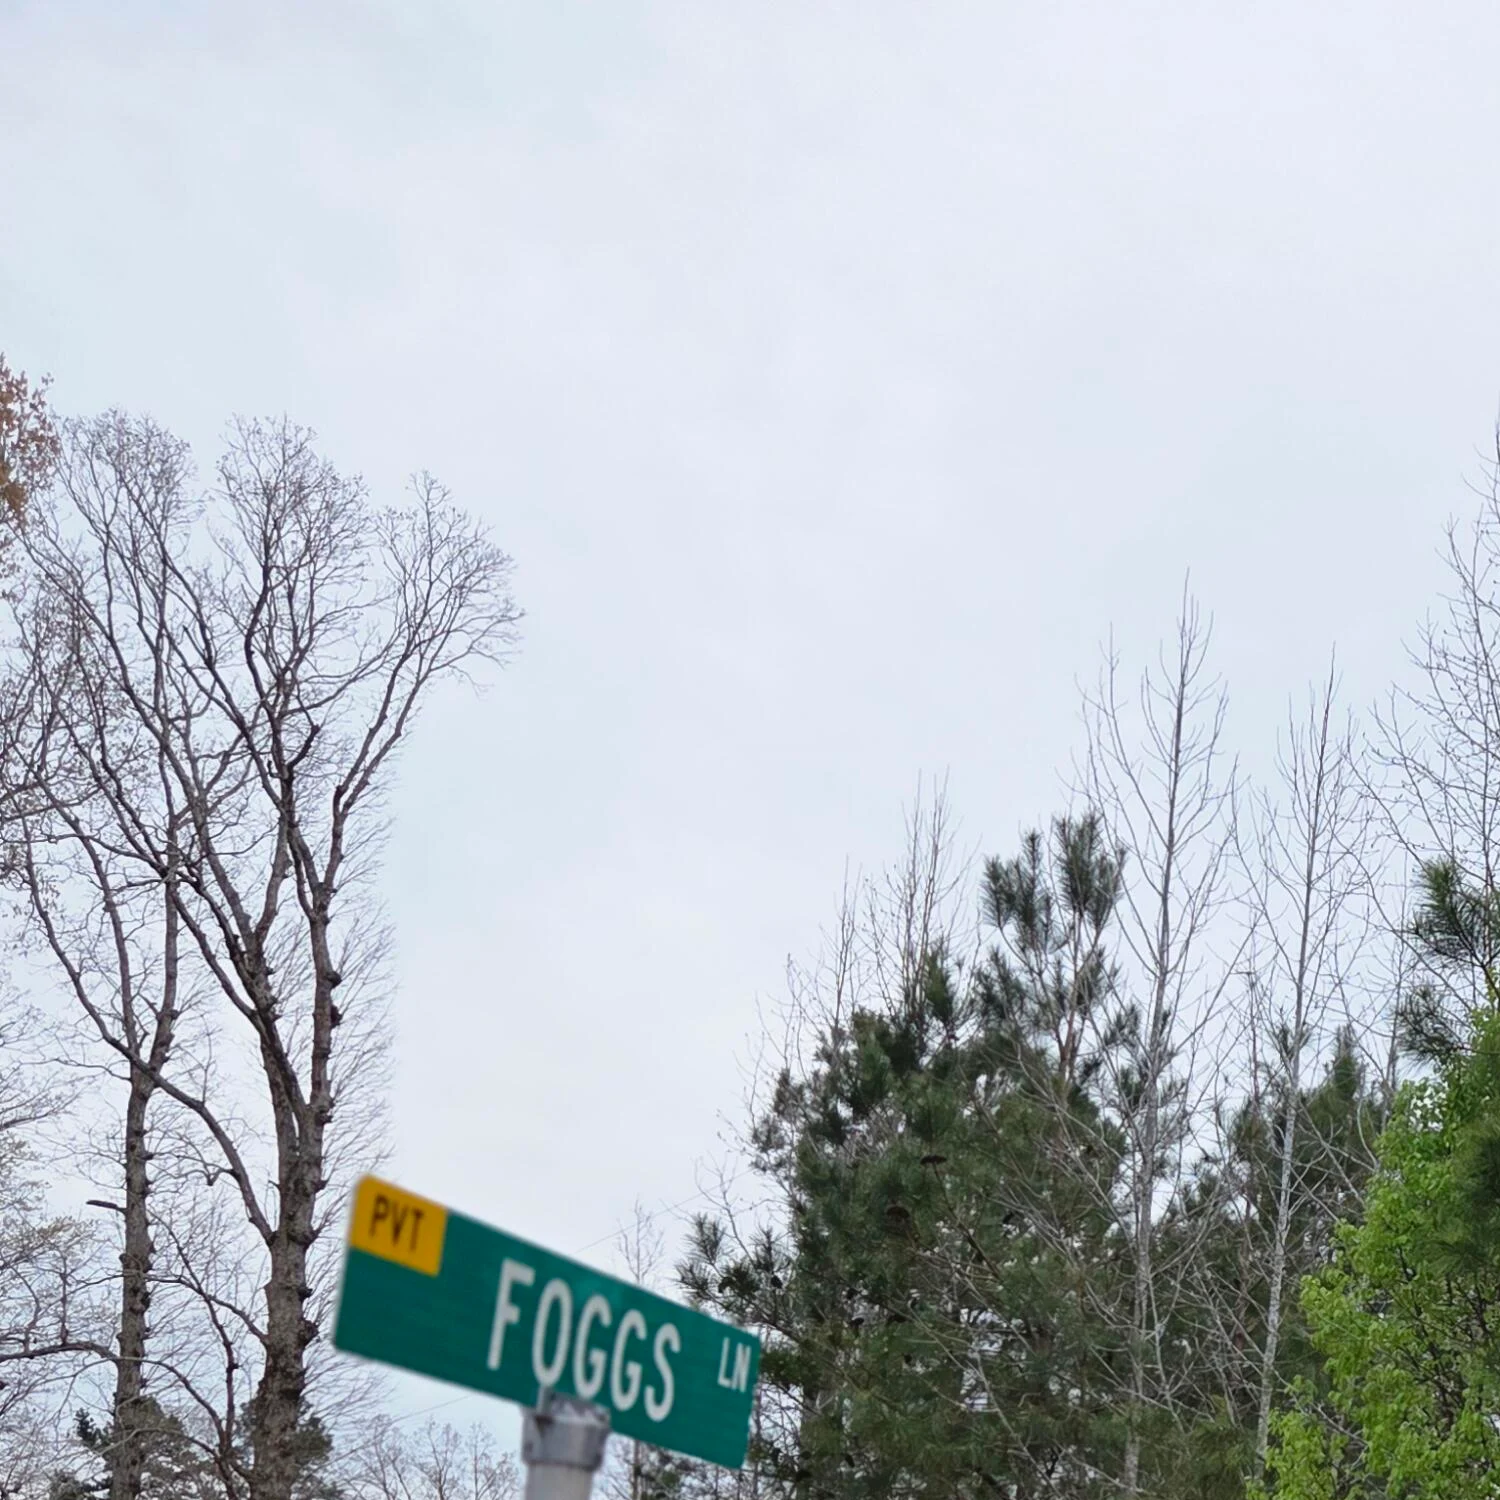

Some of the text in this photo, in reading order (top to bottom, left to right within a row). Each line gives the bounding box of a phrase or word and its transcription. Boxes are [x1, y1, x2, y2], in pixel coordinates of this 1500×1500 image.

[368, 1194, 425, 1253] PVT
[487, 1257, 752, 1422] FOGGS LN
